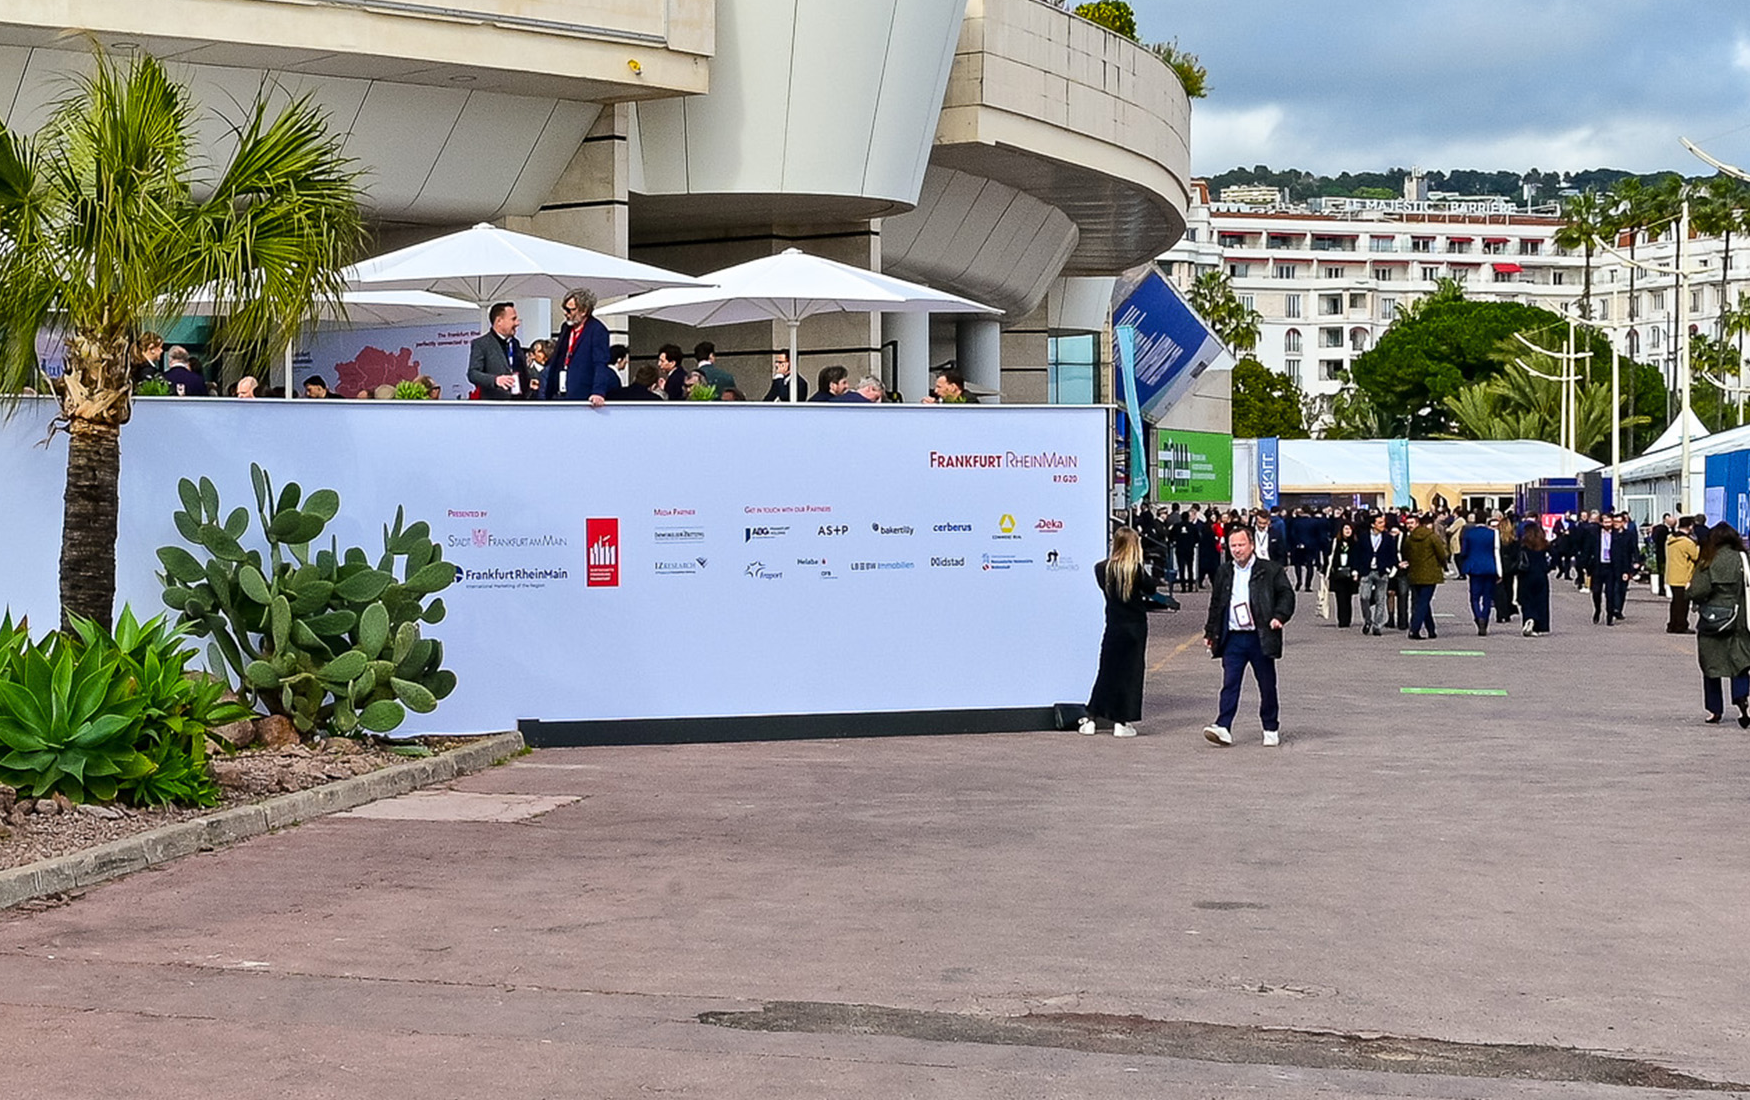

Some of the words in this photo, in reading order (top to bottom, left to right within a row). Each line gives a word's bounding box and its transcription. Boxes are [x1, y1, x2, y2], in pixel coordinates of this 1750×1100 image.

[1366, 200, 1434, 212] MAJESTIC
[930, 452, 1002, 468] FRANKFURT
[933, 522, 972, 532] cerberus
[1037, 519, 1063, 528] Deka
[818, 526, 848, 536] AS+P
